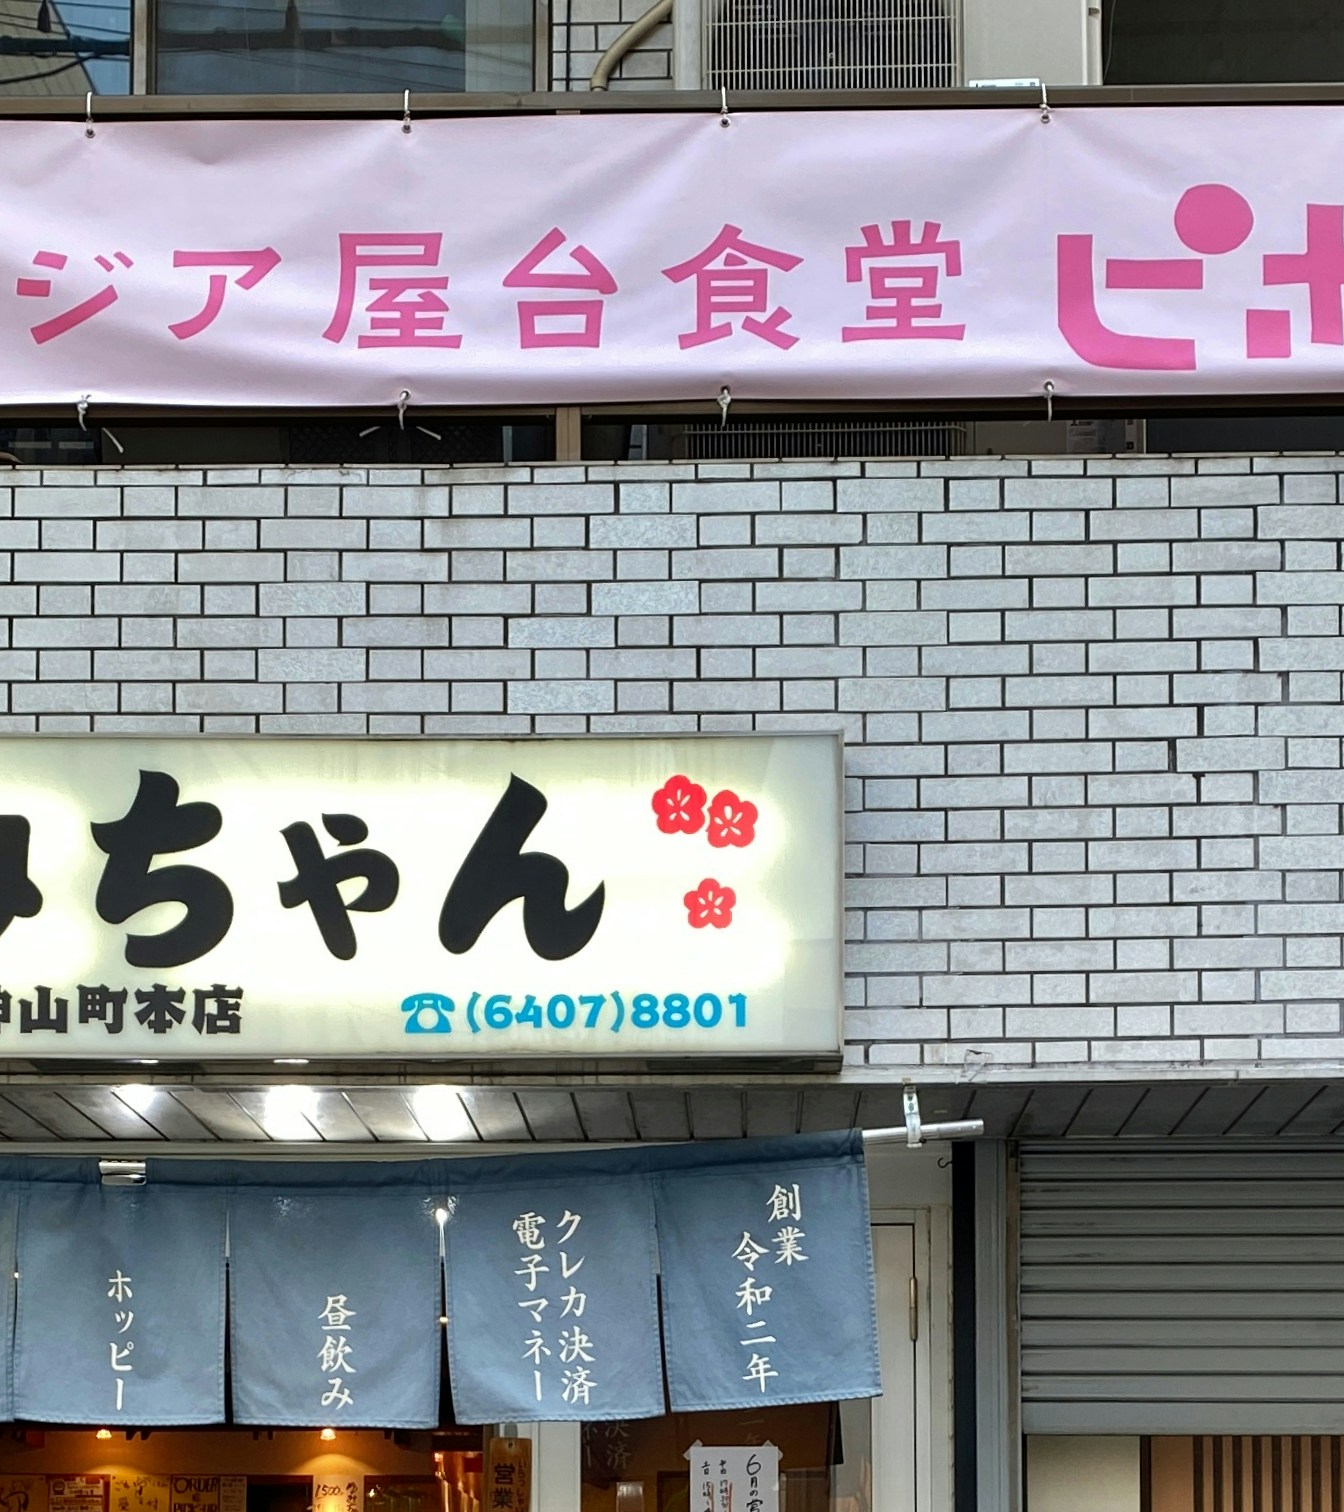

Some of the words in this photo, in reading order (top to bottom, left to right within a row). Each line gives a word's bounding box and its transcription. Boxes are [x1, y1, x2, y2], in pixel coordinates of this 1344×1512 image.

[465, 990, 748, 1035] (6407)8801
[767, 1184, 806, 1266] 創業
[107, 1270, 133, 1412] ホッピー
[316, 1293, 358, 1411] 昼飲み
[511, 1211, 553, 1402] 電子マネー
[556, 1209, 599, 1406] クレカ決済
[731, 1231, 780, 1394] 令和二年
